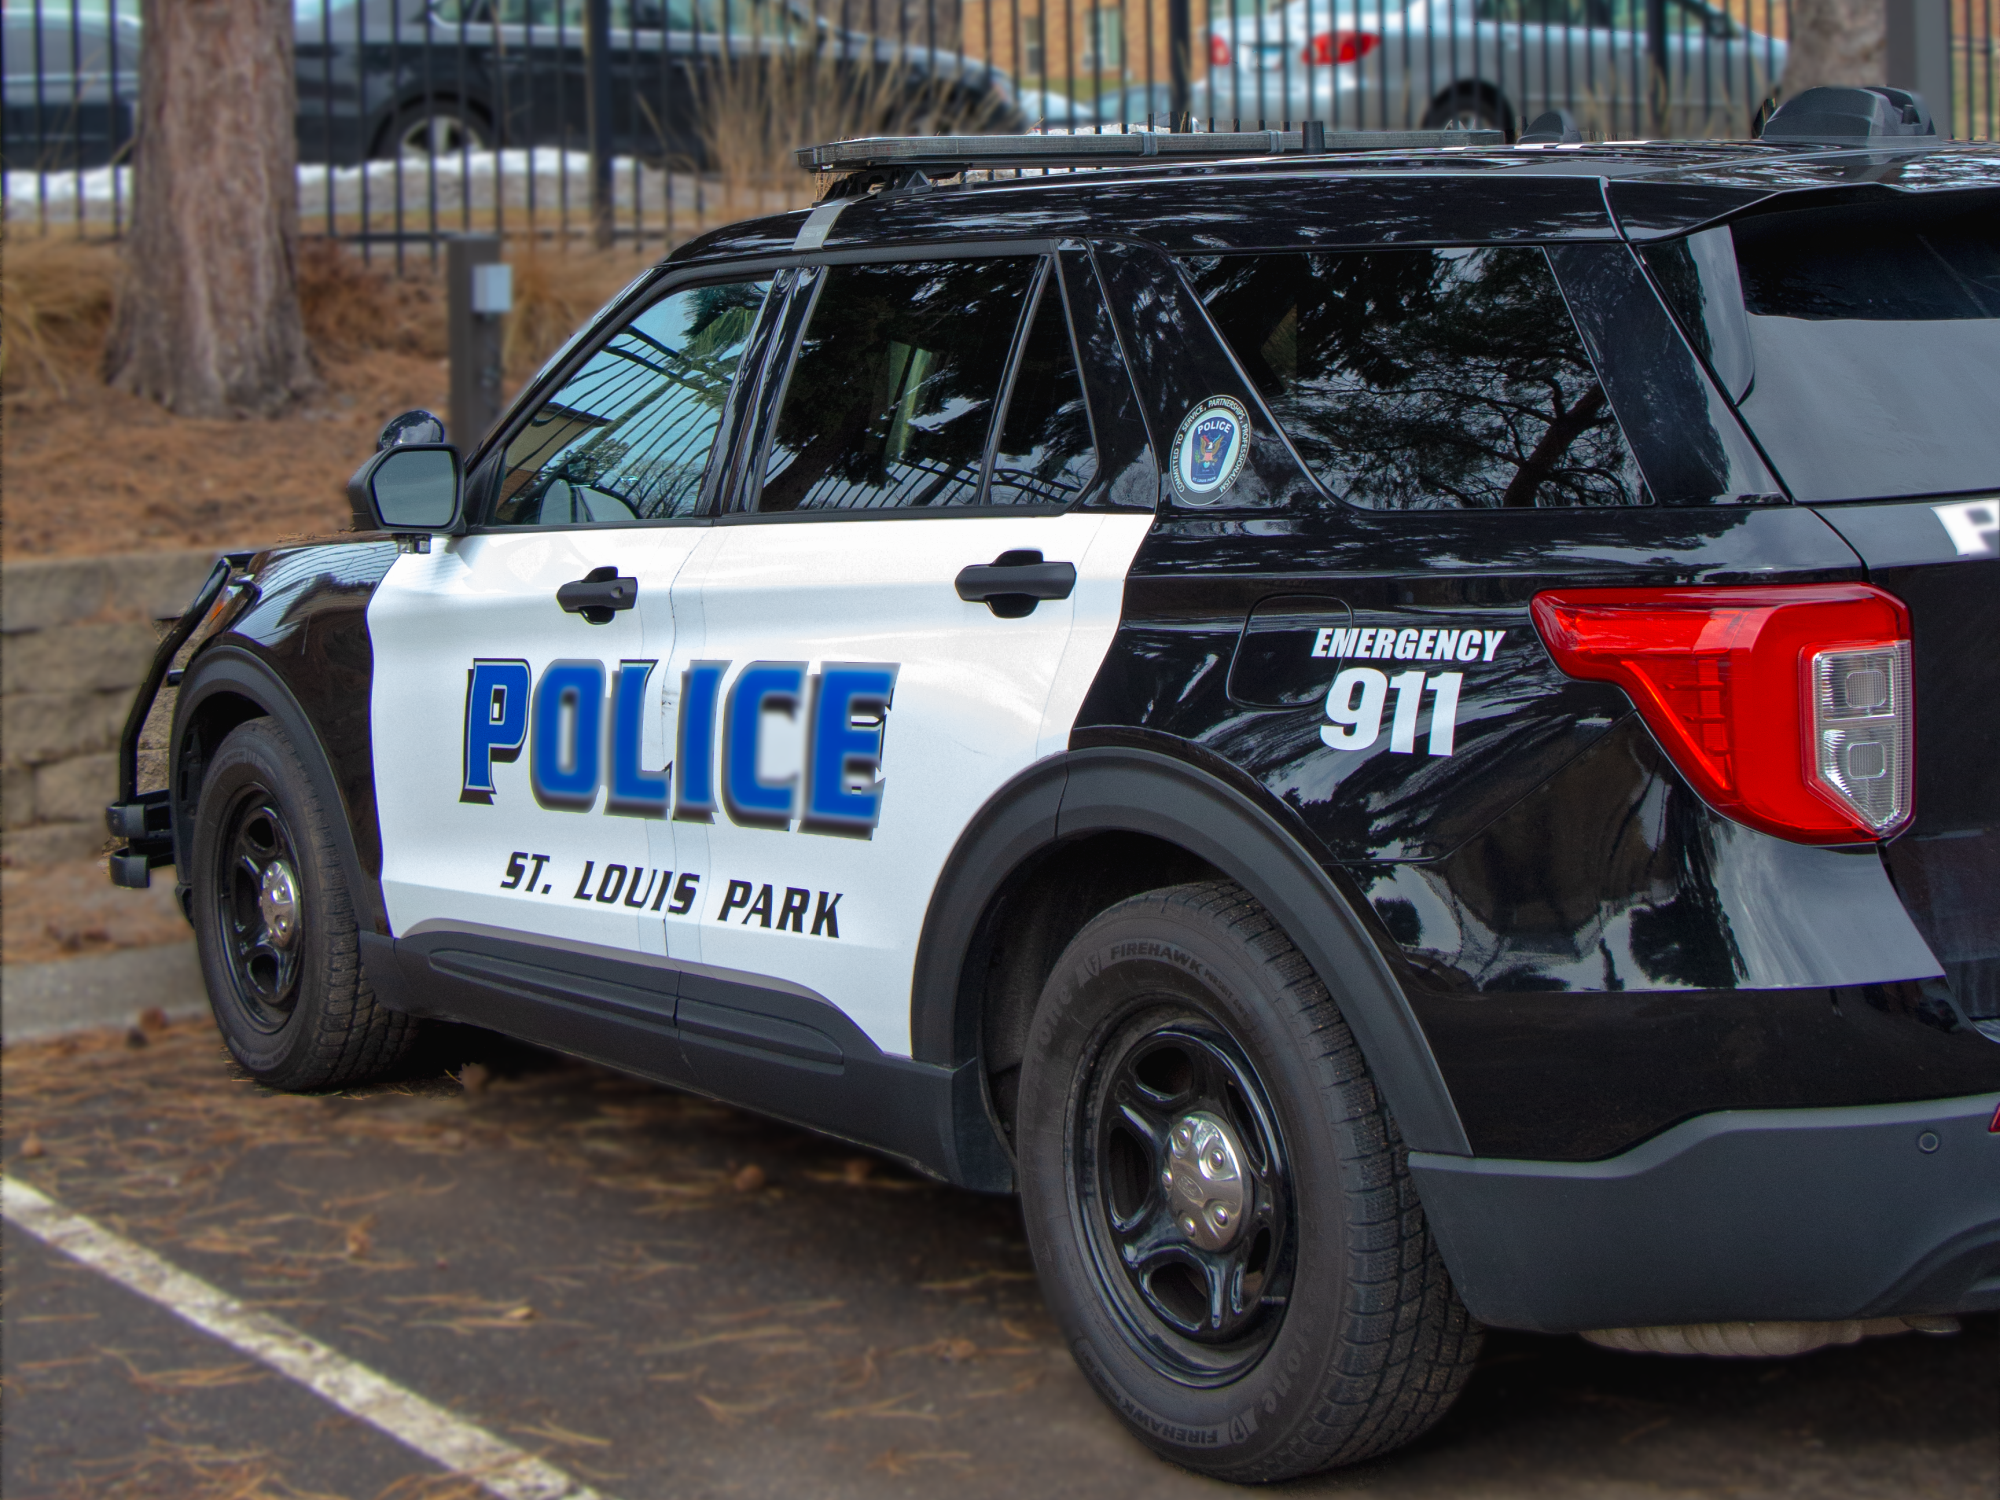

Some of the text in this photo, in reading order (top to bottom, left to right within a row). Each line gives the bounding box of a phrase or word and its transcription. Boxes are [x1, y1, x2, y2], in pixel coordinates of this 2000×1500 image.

[1175, 433, 1184, 446] TO
[1197, 420, 1232, 435] POLICE
[1172, 448, 1185, 493] COMMITTED
[1219, 423, 1249, 493] PROFESSIONALISM
[1311, 627, 1506, 662] EMERGENCY
[1320, 667, 1464, 757] 911
[459, 658, 902, 841] POLICE
[500, 851, 843, 938] ST. LOUIS PARK
[1110, 942, 1203, 973] FIREHAWK
[1122, 1398, 1218, 1444] FIREHAWK
